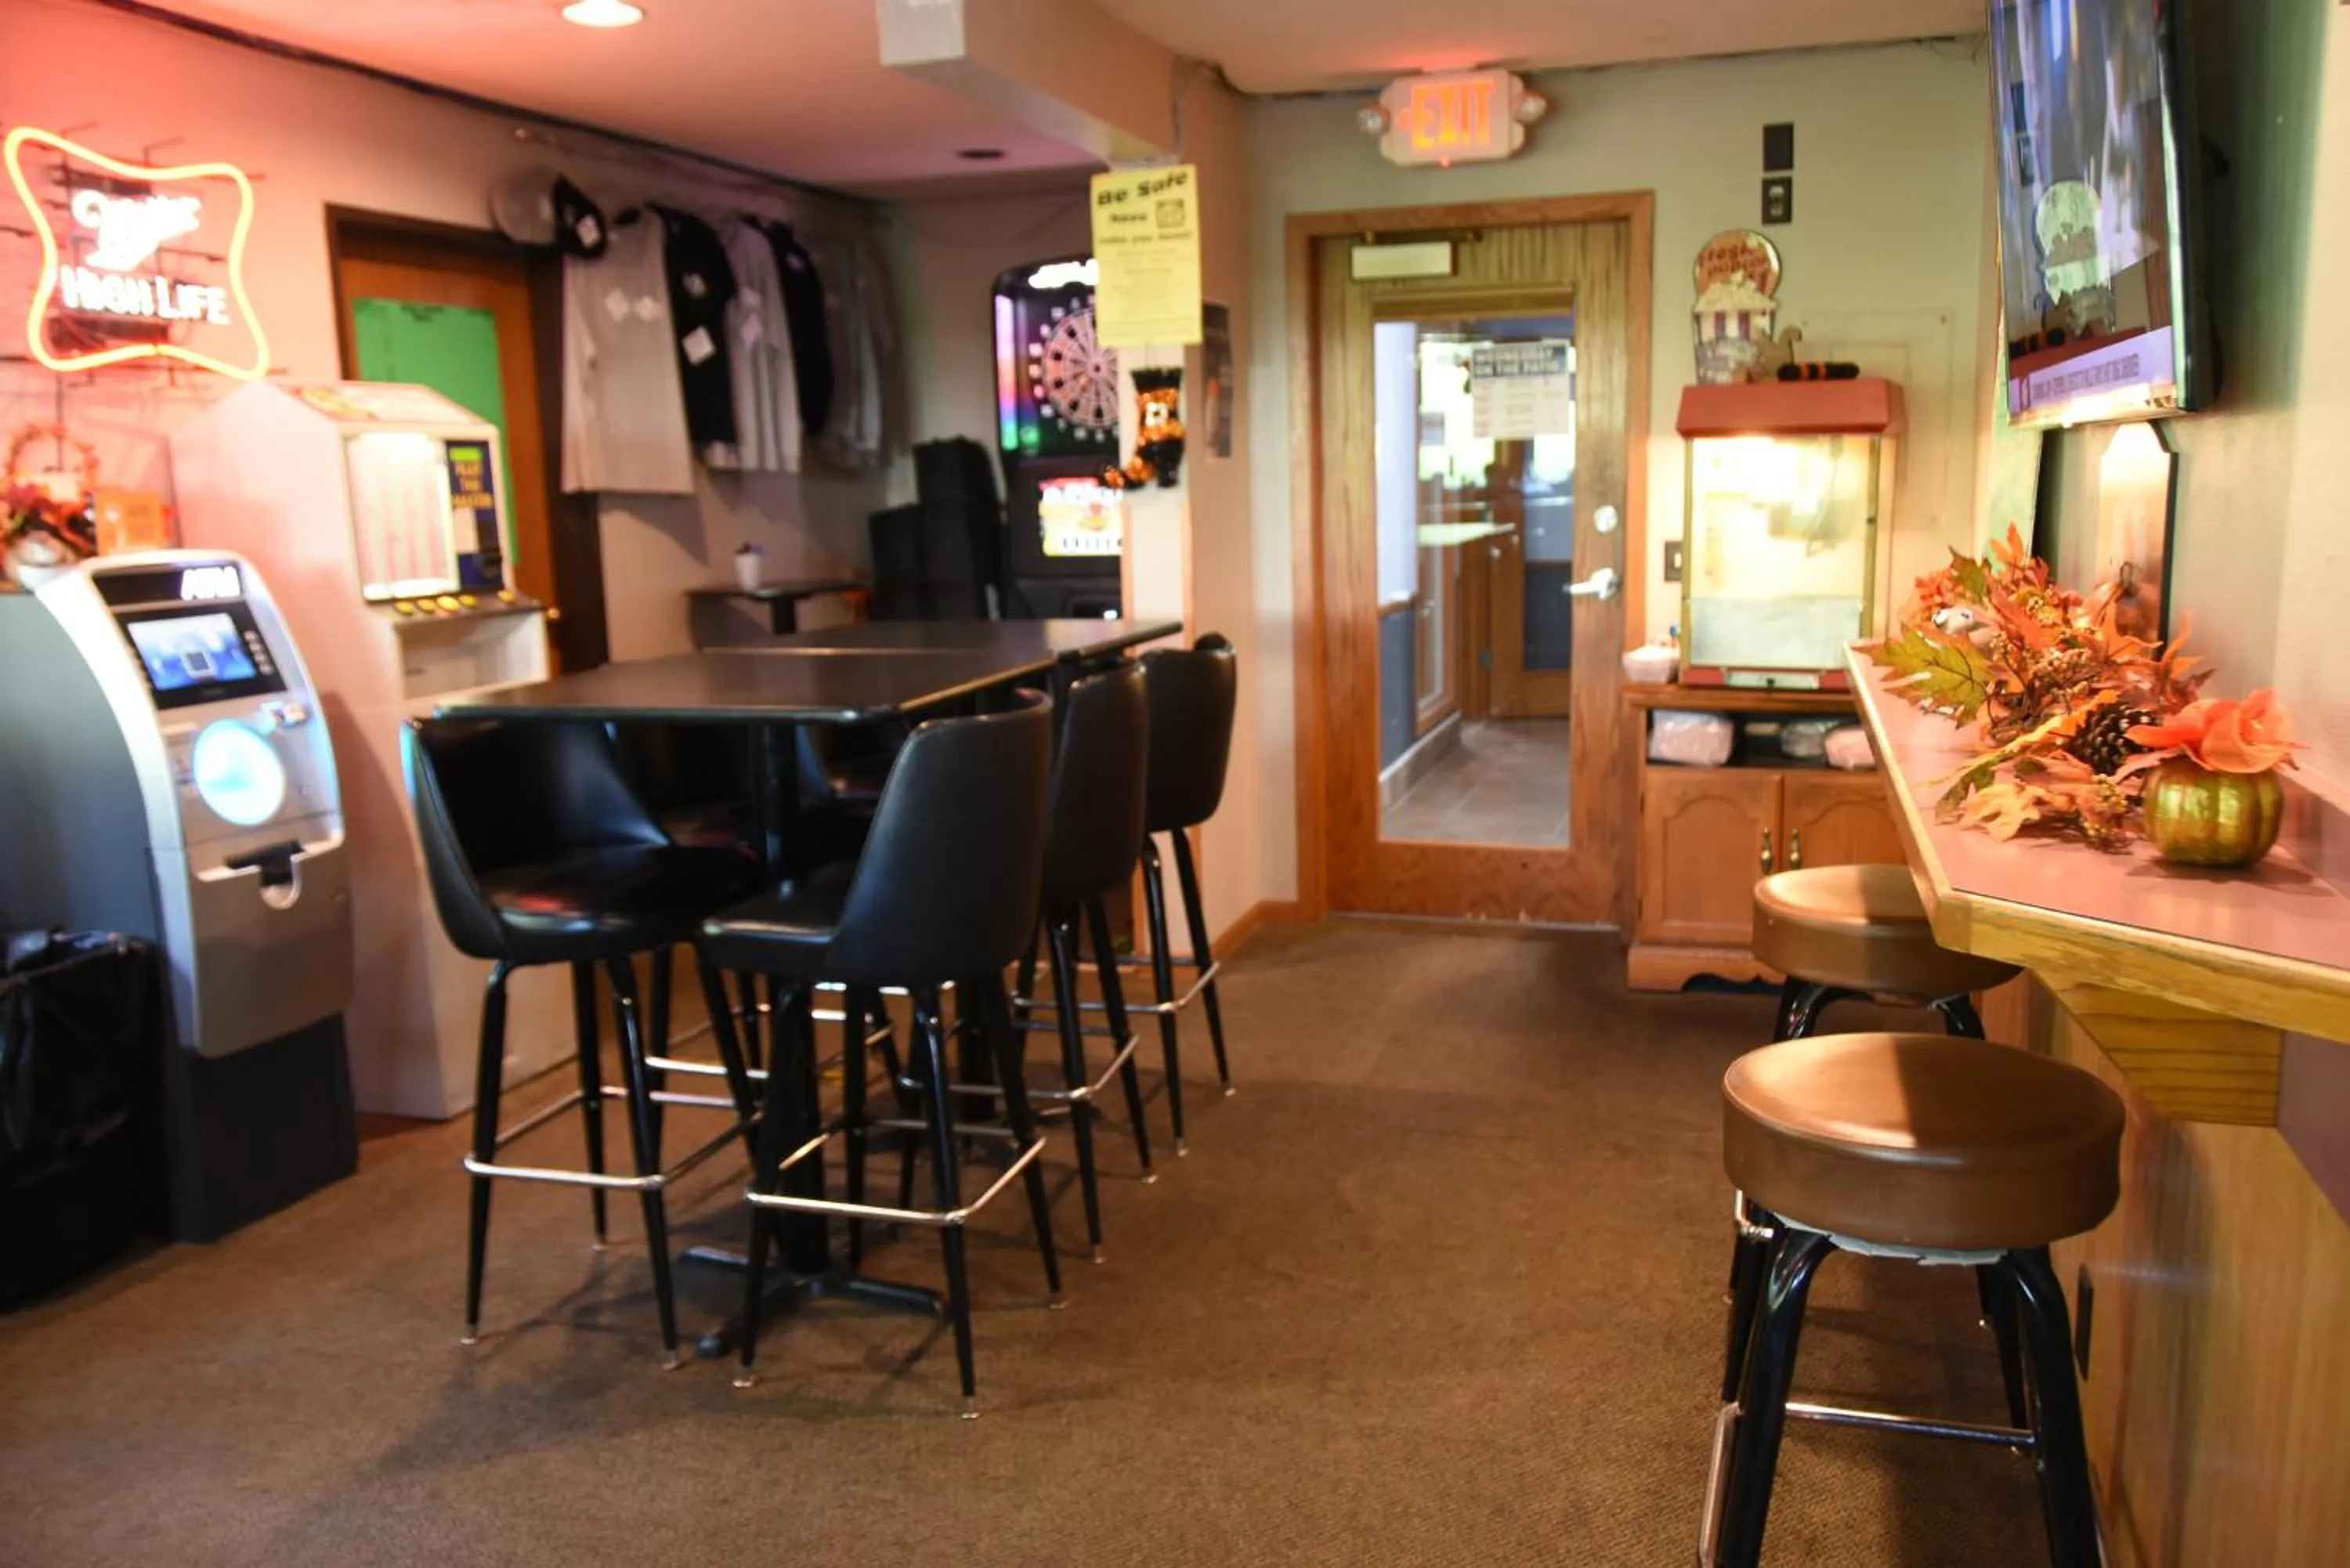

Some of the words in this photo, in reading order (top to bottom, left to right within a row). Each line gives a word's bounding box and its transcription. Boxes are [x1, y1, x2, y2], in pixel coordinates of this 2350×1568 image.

[1412, 79, 1494, 149] EXIT
[1097, 188, 1128, 206] Be
[1137, 171, 1188, 197] Safe
[60, 265, 154, 316] HIGH
[155, 275, 231, 326] LIFE
